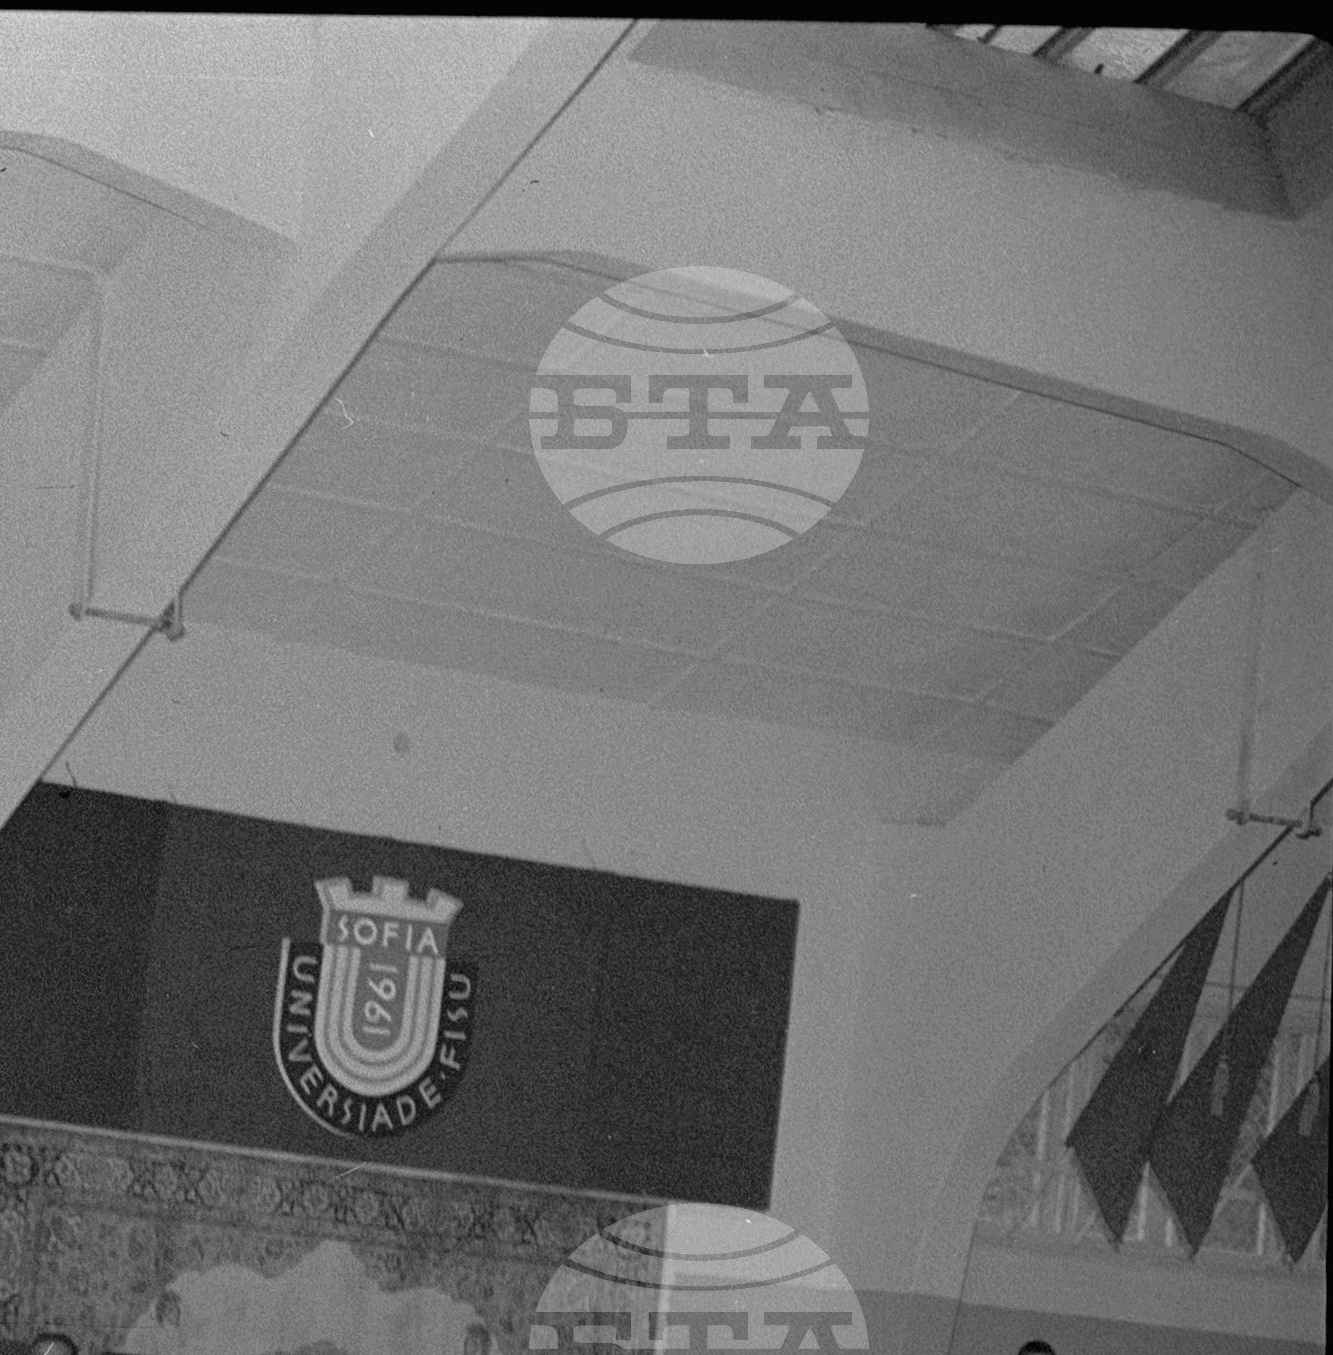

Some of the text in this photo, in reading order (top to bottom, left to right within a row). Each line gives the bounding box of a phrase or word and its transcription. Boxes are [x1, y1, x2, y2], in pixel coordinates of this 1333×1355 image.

[338, 915, 439, 954] SOFIA
[362, 962, 398, 1036] 1961
[286, 955, 471, 1133] UNIVERSIADE FISU
